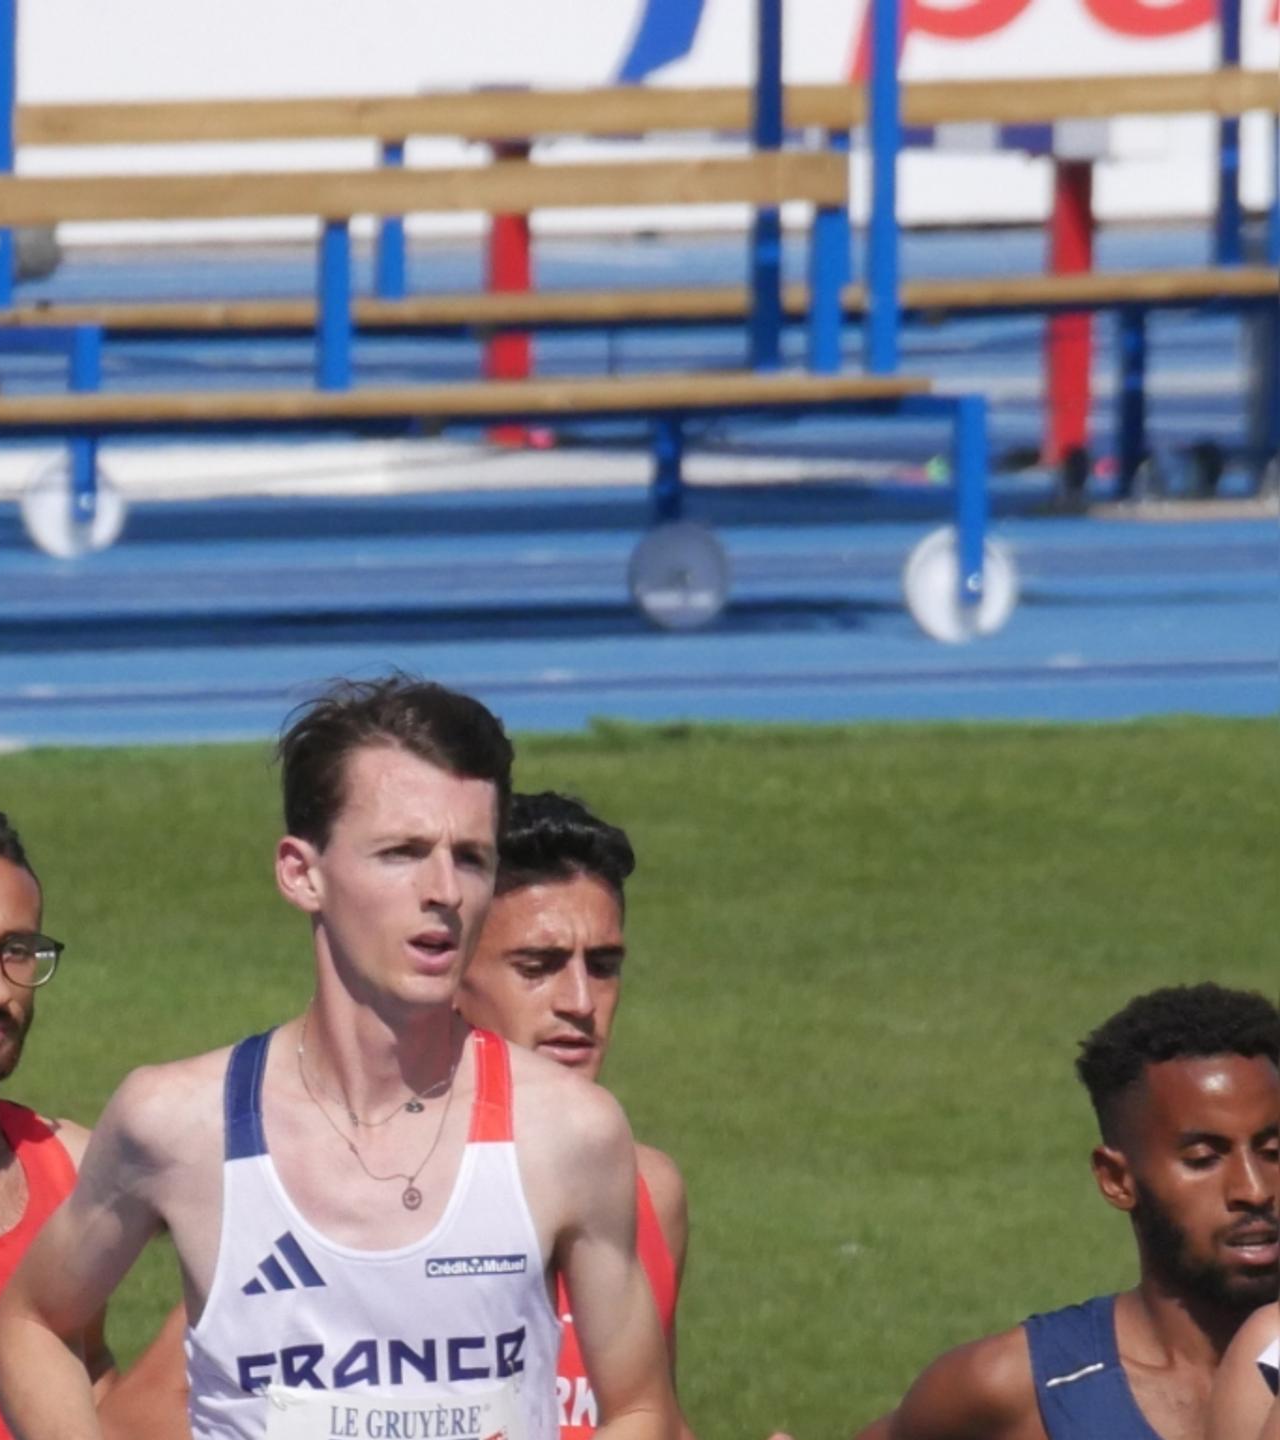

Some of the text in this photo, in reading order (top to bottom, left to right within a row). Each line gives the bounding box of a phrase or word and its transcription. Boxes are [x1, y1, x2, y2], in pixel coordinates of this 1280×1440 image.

[237, 1325, 526, 1393] FRANCE
[330, 1403, 482, 1440] LE GRUYÈRE
